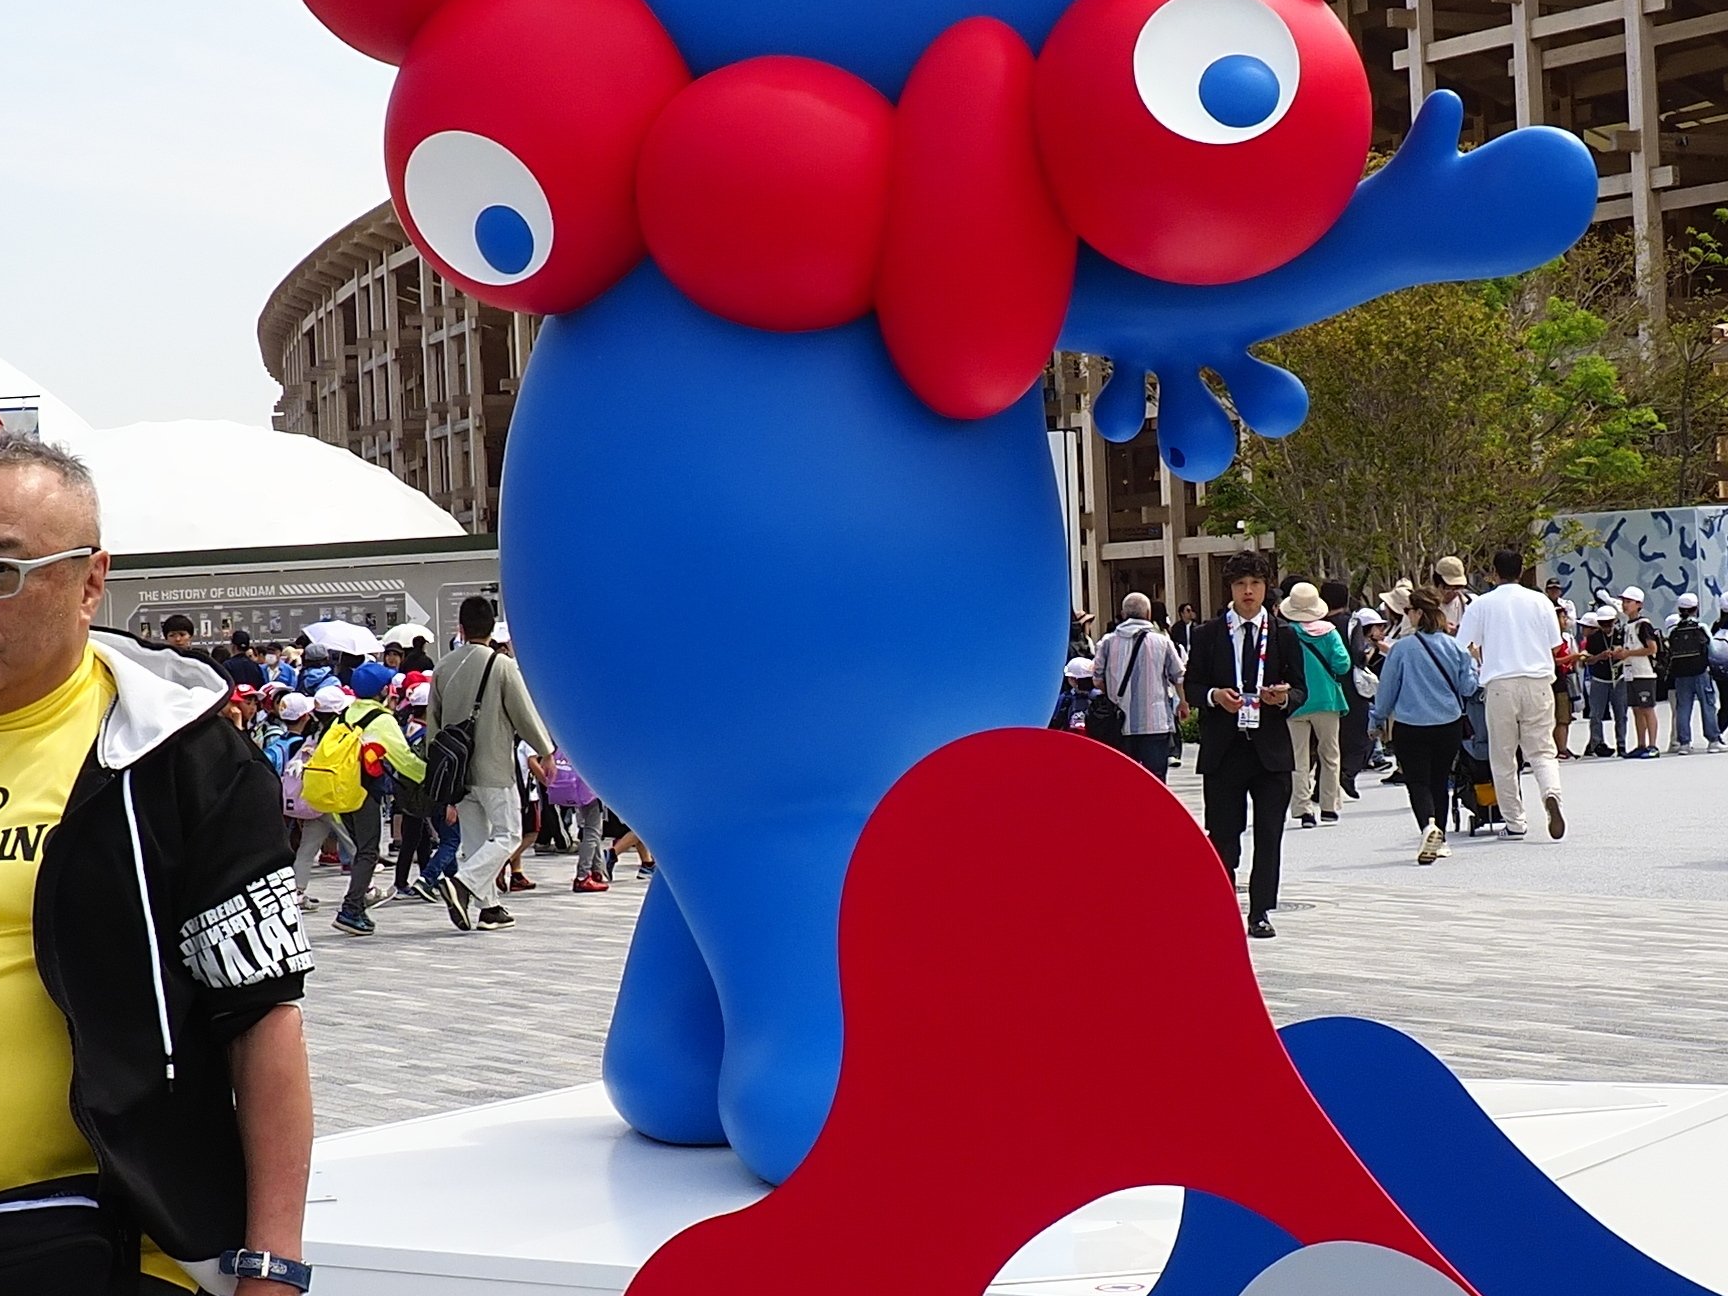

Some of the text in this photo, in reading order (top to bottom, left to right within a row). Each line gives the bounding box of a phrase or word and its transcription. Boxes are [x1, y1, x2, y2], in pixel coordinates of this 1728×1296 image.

[139, 585, 275, 601] THE HISTORY OF GUNDAM
